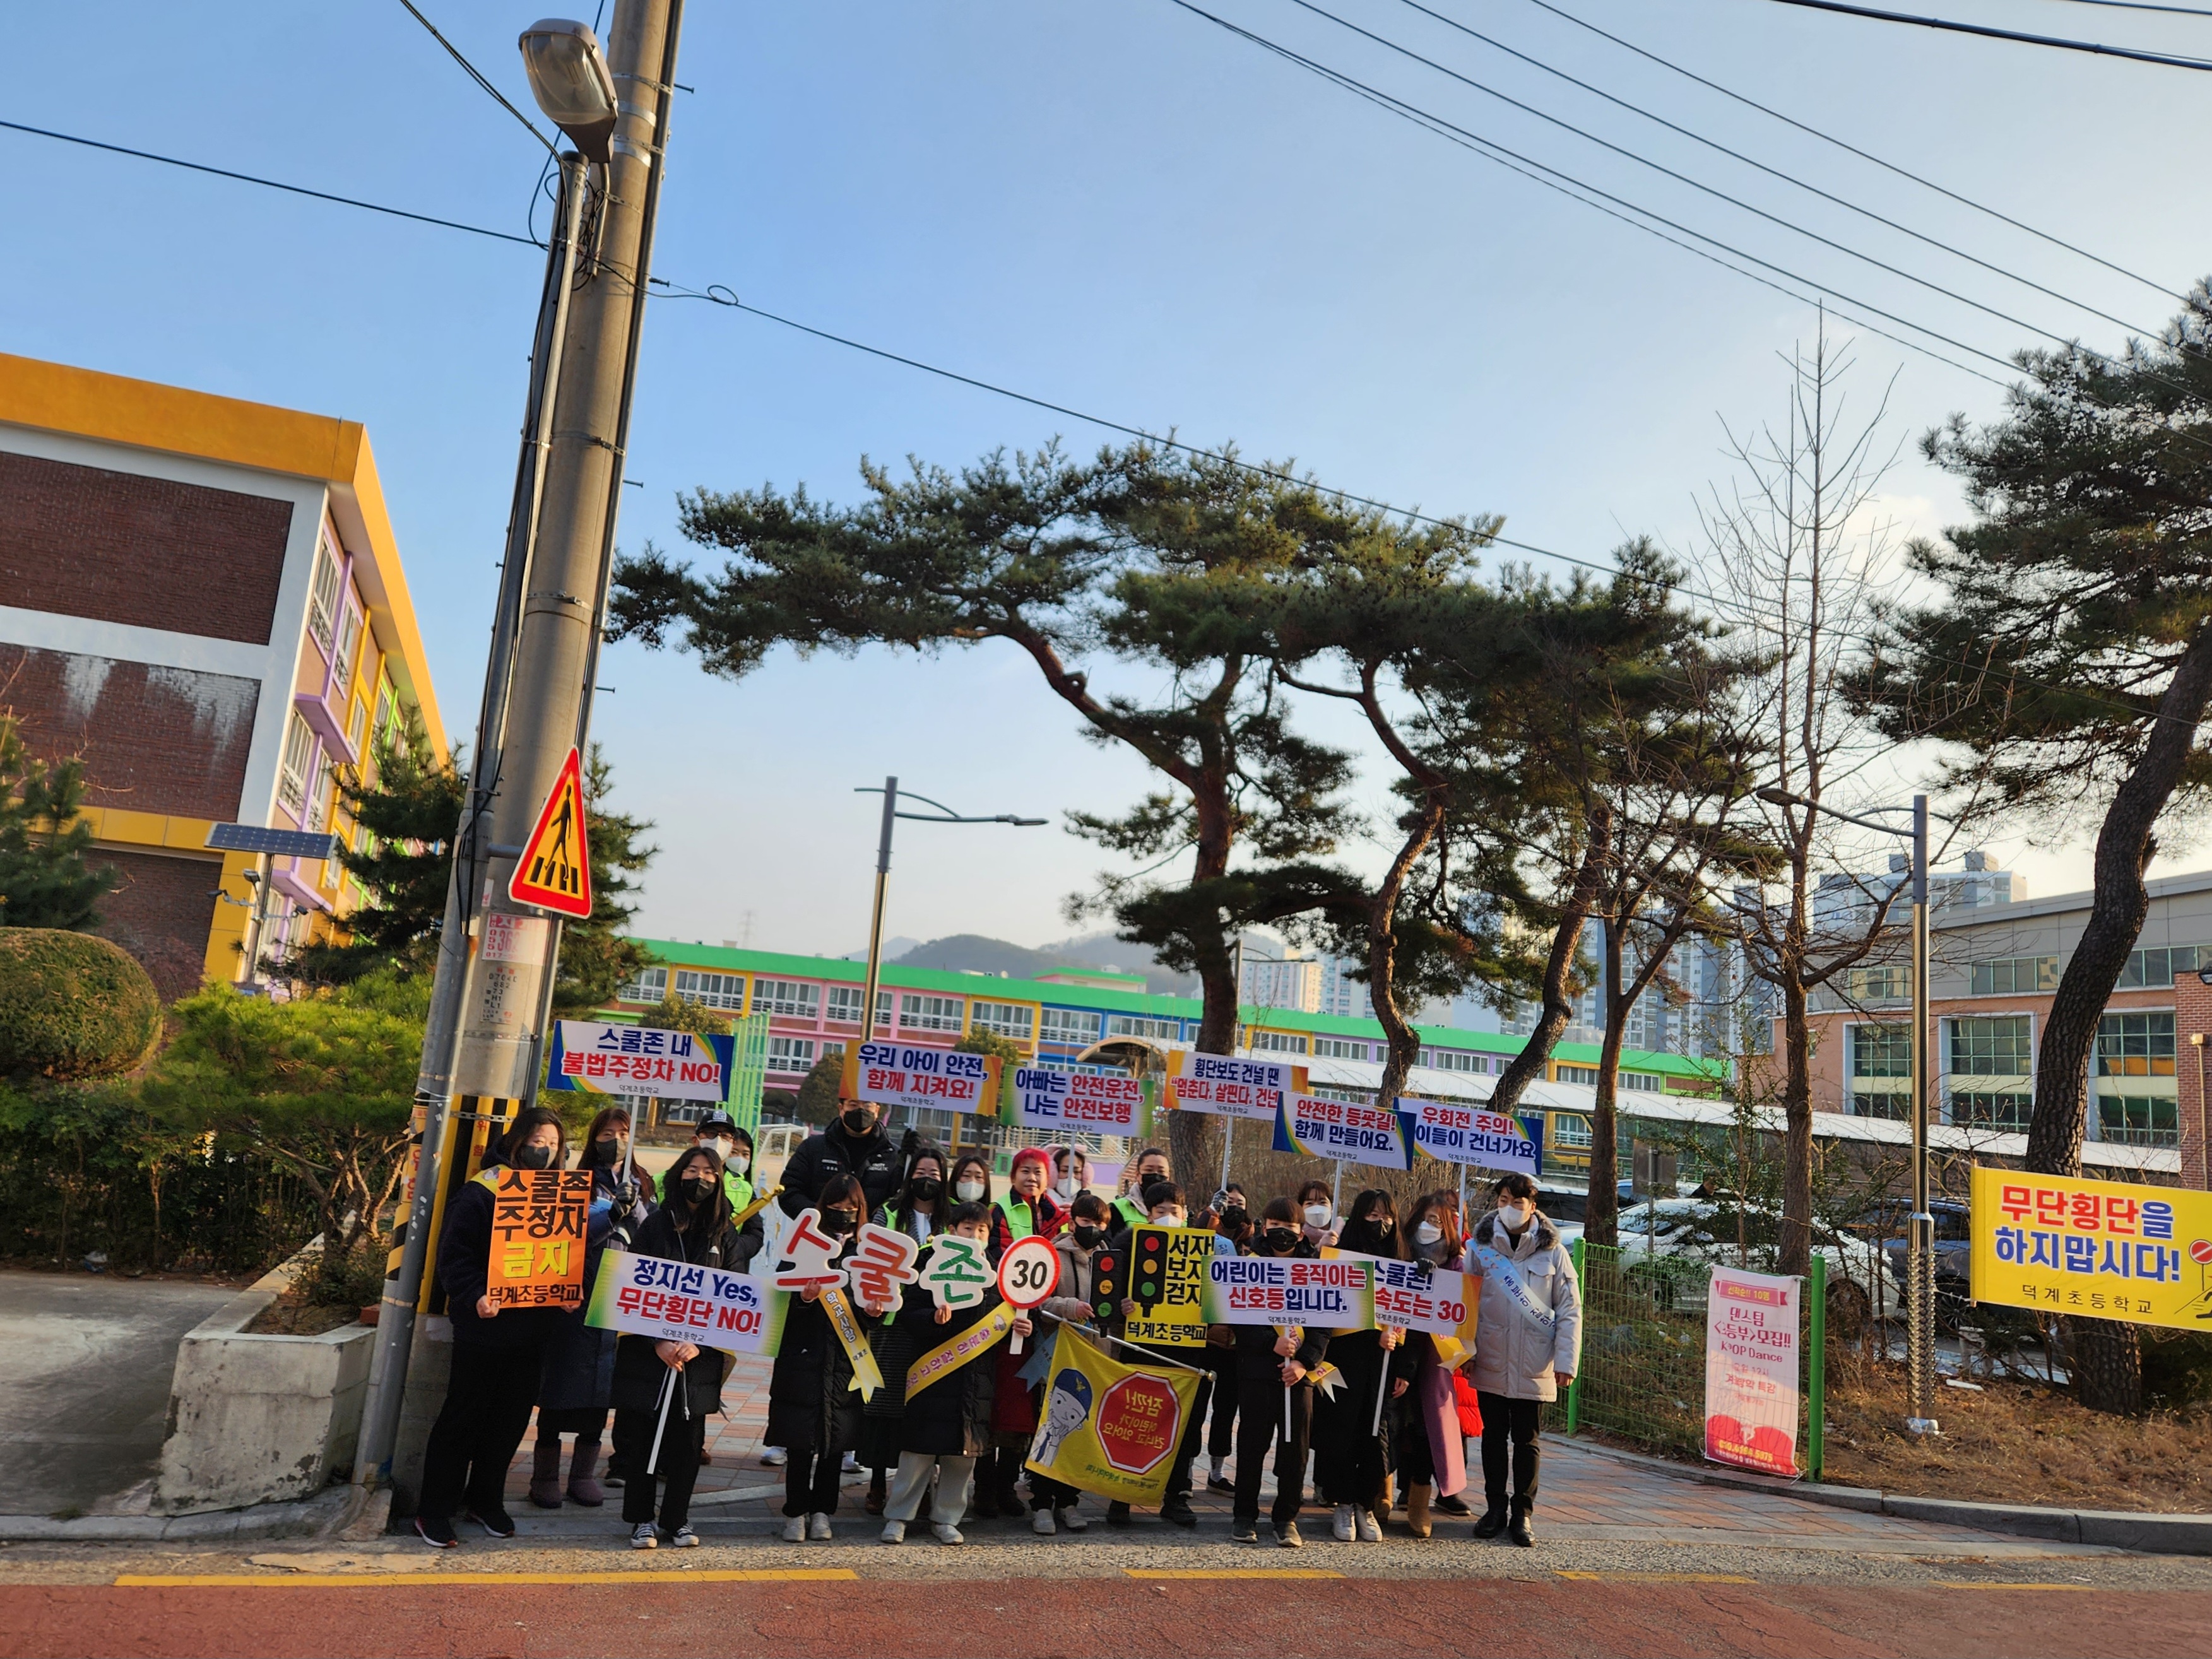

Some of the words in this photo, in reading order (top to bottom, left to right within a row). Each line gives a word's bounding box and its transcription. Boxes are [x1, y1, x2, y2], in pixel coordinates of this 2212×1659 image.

[598, 1029, 664, 1054] 스쿨존
[671, 1034, 692, 1057] 내
[563, 1051, 675, 1082] 불법주정차
[680, 1062, 719, 1083] NO!
[858, 1044, 896, 1067] 우리
[902, 1049, 940, 1073] 아이
[945, 1054, 988, 1080] 안전,
[1195, 1058, 1239, 1081] 횡단보도
[1242, 1064, 1265, 1085] 건널
[1268, 1067, 1280, 1087] 땐
[619, 1085, 659, 1094] 덕계초등학교
[867, 1068, 905, 1092] 함께
[910, 1074, 974, 1099] 지켜요!
[1015, 1069, 1067, 1094] 아빠는
[1072, 1075, 1144, 1103] 안전운전,
[1215, 1083, 1252, 1105] 살핀다.
[1256, 1087, 1279, 1109] 건넌
[901, 1097, 935, 1105] 덕계초등학교
[1024, 1093, 1058, 1116] 나는
[1063, 1097, 1132, 1124] 안전보행
[1217, 1105, 1248, 1114] 덕계초등학교
[1298, 1099, 1343, 1123] 안전한
[1346, 1107, 1397, 1131] 등굣길!
[1060, 1123, 1093, 1131] 덕계초등학교
[1295, 1119, 1325, 1142] 함께
[1329, 1125, 1393, 1151] 만들어요.
[1422, 1106, 1470, 1130] 우회전
[1476, 1114, 1514, 1135] 주의!
[1326, 1150, 1357, 1160] 덕계초등학교
[1416, 1125, 1464, 1148] 이들이
[1469, 1133, 1535, 1159] 건너가요
[1448, 1154, 1482, 1164] 덕계초등학교
[497, 1171, 591, 1204] 스쿨존
[494, 1205, 587, 1241] 주정차
[2001, 1185, 2174, 1239] 무단횡단을
[503, 1240, 571, 1278] 금지
[1996, 1226, 2180, 1282] 하지맙시다!
[634, 1258, 705, 1295] 정지선
[712, 1273, 758, 1307] Yes,
[1012, 1260, 1047, 1290] 30
[1210, 1261, 1285, 1285] 어린이는
[1290, 1263, 1366, 1288] 움직이는
[490, 1284, 581, 1305] 덕계초등학교
[1229, 1286, 1347, 1312] 신호등입니다.
[1503, 1275, 1531, 1307] 충분히
[2021, 1284, 2153, 1314] 덕계초등학교
[617, 1287, 714, 1328] 무단횡단
[717, 1306, 762, 1334] NO!
[825, 1290, 856, 1343] 학교사랑
[1268, 1316, 1307, 1325] 덕계초등학교
[1375, 1313, 1411, 1325] 덕계초등학교
[1438, 1300, 1465, 1323] 30
[1730, 1307, 1764, 1327] 댄스팀
[662, 1328, 704, 1342] 덕계초등학교
[1128, 1321, 1207, 1342] 덕계초등학교
[920, 1350, 954, 1378] 잘하고
[1749, 1347, 1783, 1362] Dance
[1759, 1381, 1776, 1394] 특강
